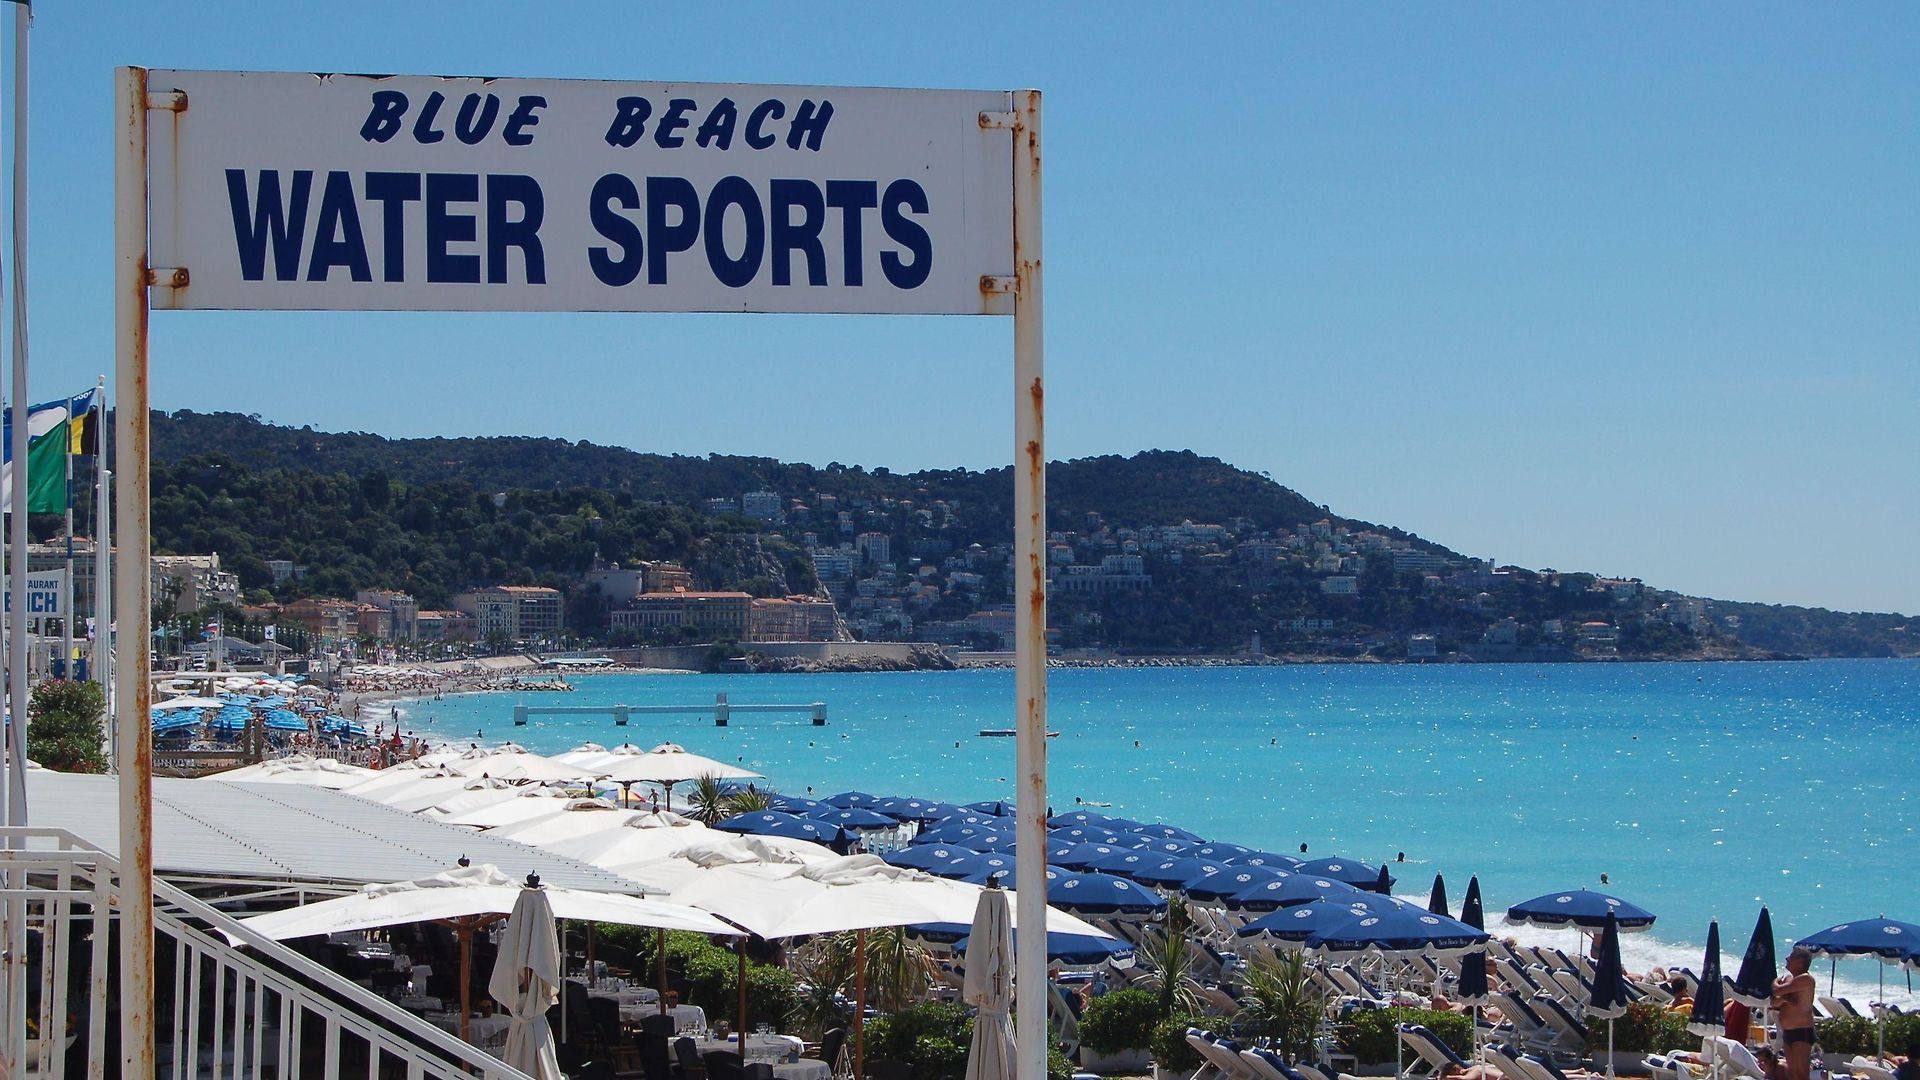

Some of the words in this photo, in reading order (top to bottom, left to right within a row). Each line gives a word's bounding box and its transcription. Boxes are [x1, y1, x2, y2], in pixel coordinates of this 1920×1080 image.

[361, 91, 547, 145] BLUE
[605, 96, 834, 151] BEACH
[225, 169, 546, 284] WATER
[588, 173, 932, 289] SPORTS
